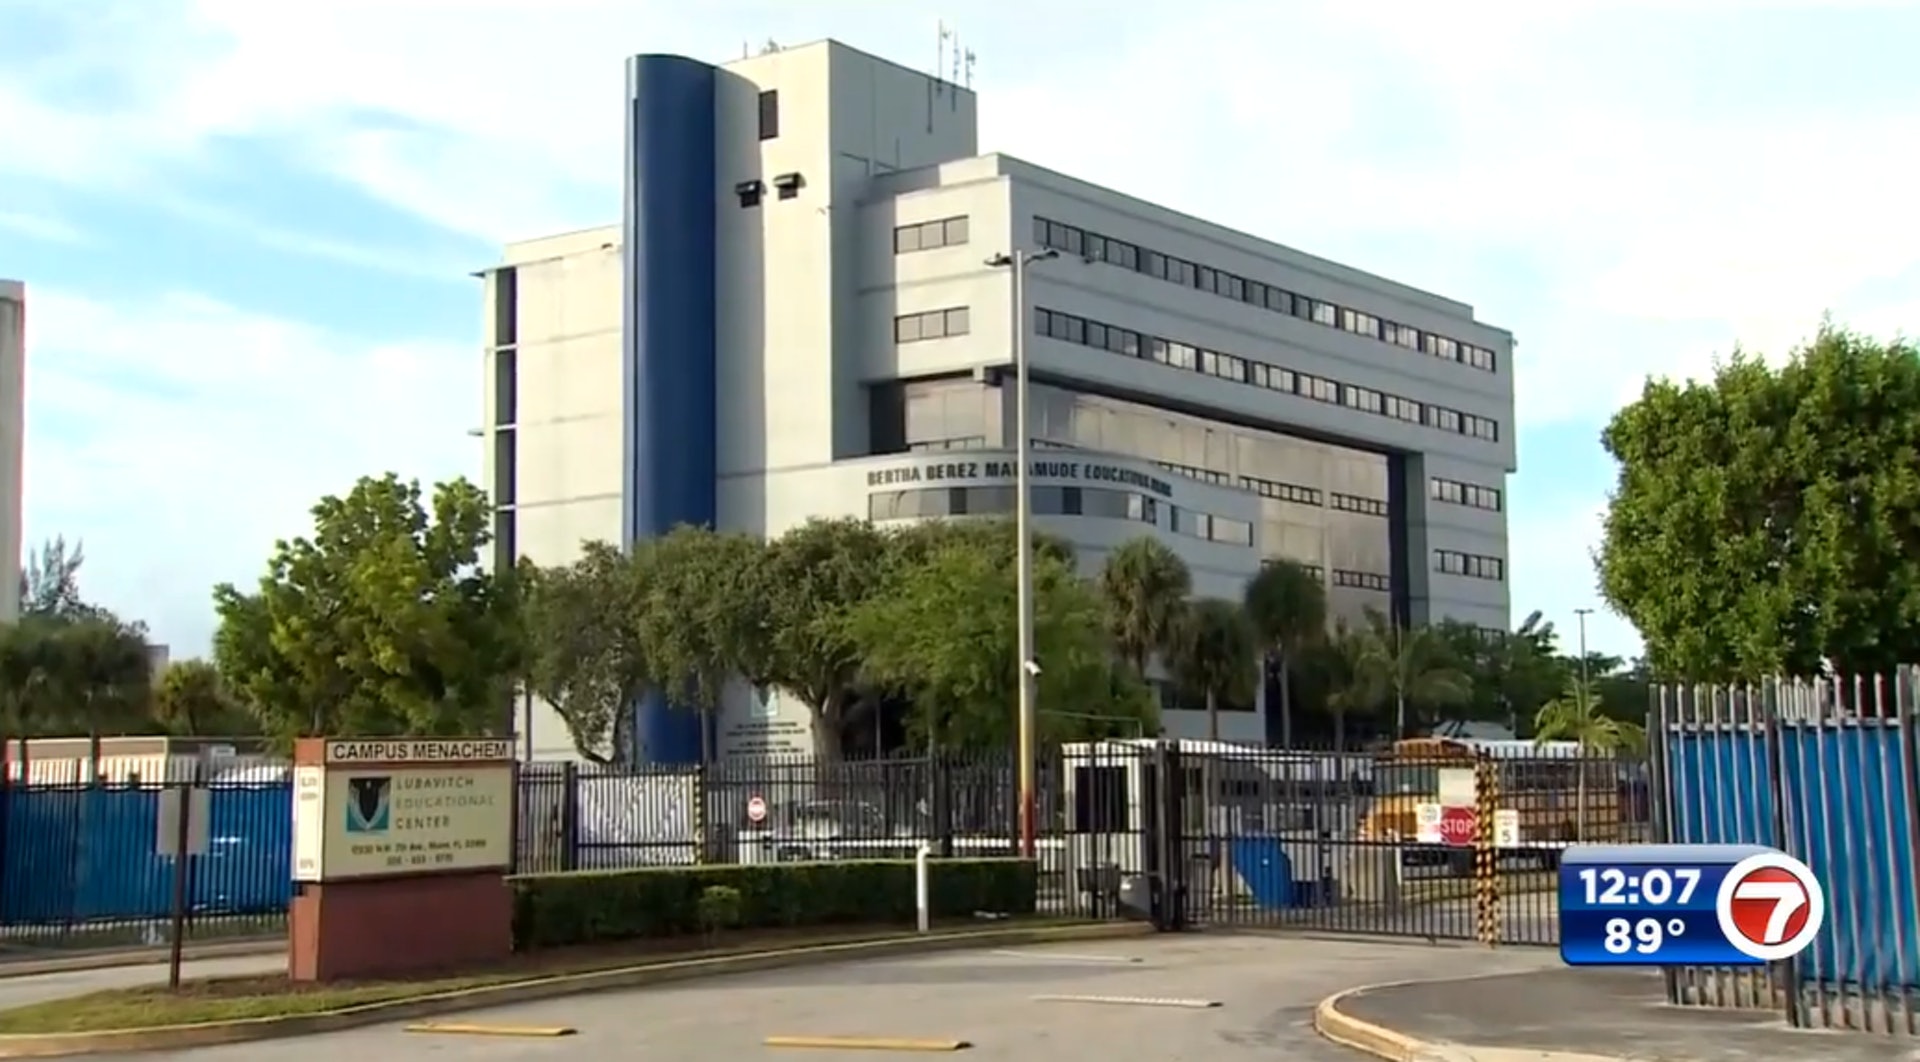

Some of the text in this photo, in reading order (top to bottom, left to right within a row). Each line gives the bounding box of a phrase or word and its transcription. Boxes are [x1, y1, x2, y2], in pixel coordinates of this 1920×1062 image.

[867, 466, 921, 486] BERTHA
[926, 462, 978, 480] BEREZ
[985, 461, 1078, 479] MAMUDE
[333, 742, 507, 760] CAMPUS MENACHEM
[396, 776, 474, 791] LUBAVITCH
[395, 794, 496, 809] EDUCATIONAL
[395, 815, 450, 830] CENTER
[1442, 819, 1474, 833] STOP
